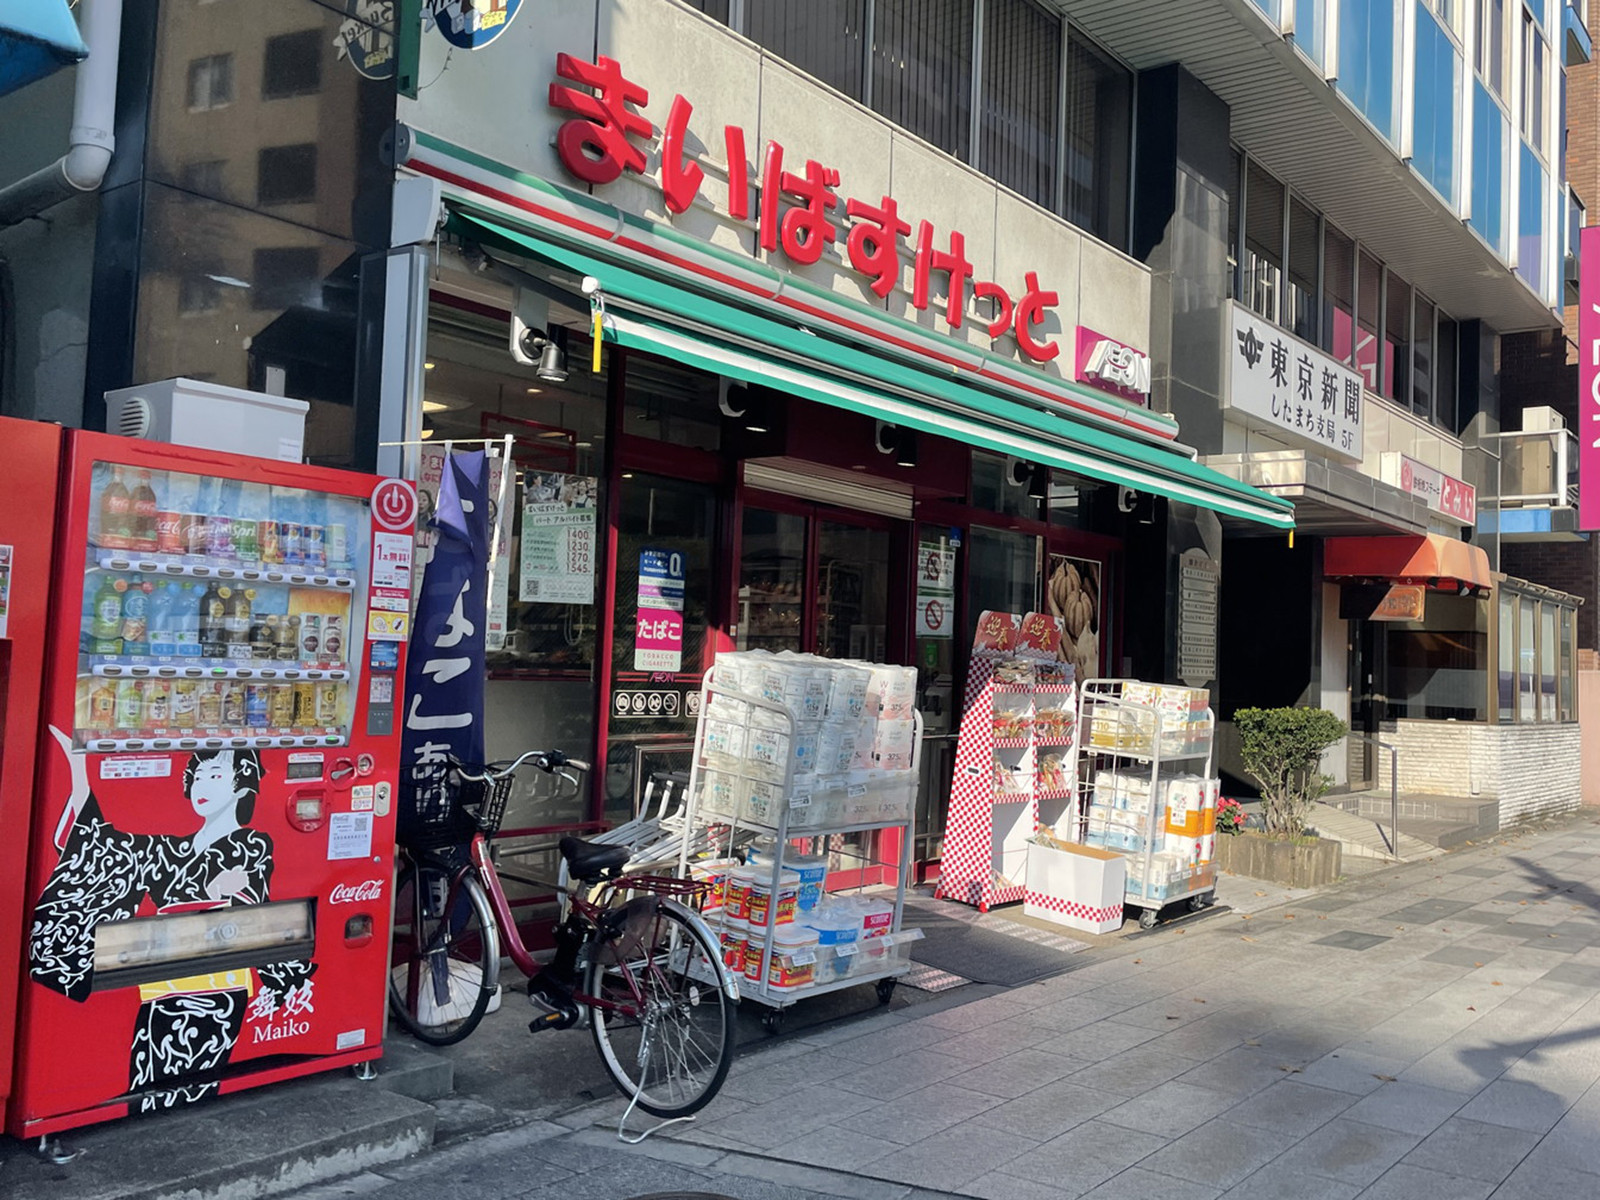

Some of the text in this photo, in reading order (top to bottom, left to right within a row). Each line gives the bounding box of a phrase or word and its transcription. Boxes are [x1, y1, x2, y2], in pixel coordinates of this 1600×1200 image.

[549, 52, 1060, 362] まいばすけっと
[1269, 338, 1360, 425] 東京新聞
[1271, 393, 1354, 450] したまち支局 5F
[637, 619, 681, 640] たばこ
[330, 880, 385, 904] Coca-Cola
[247, 978, 315, 1022] 舞妓
[253, 1019, 310, 1044] Maiko
